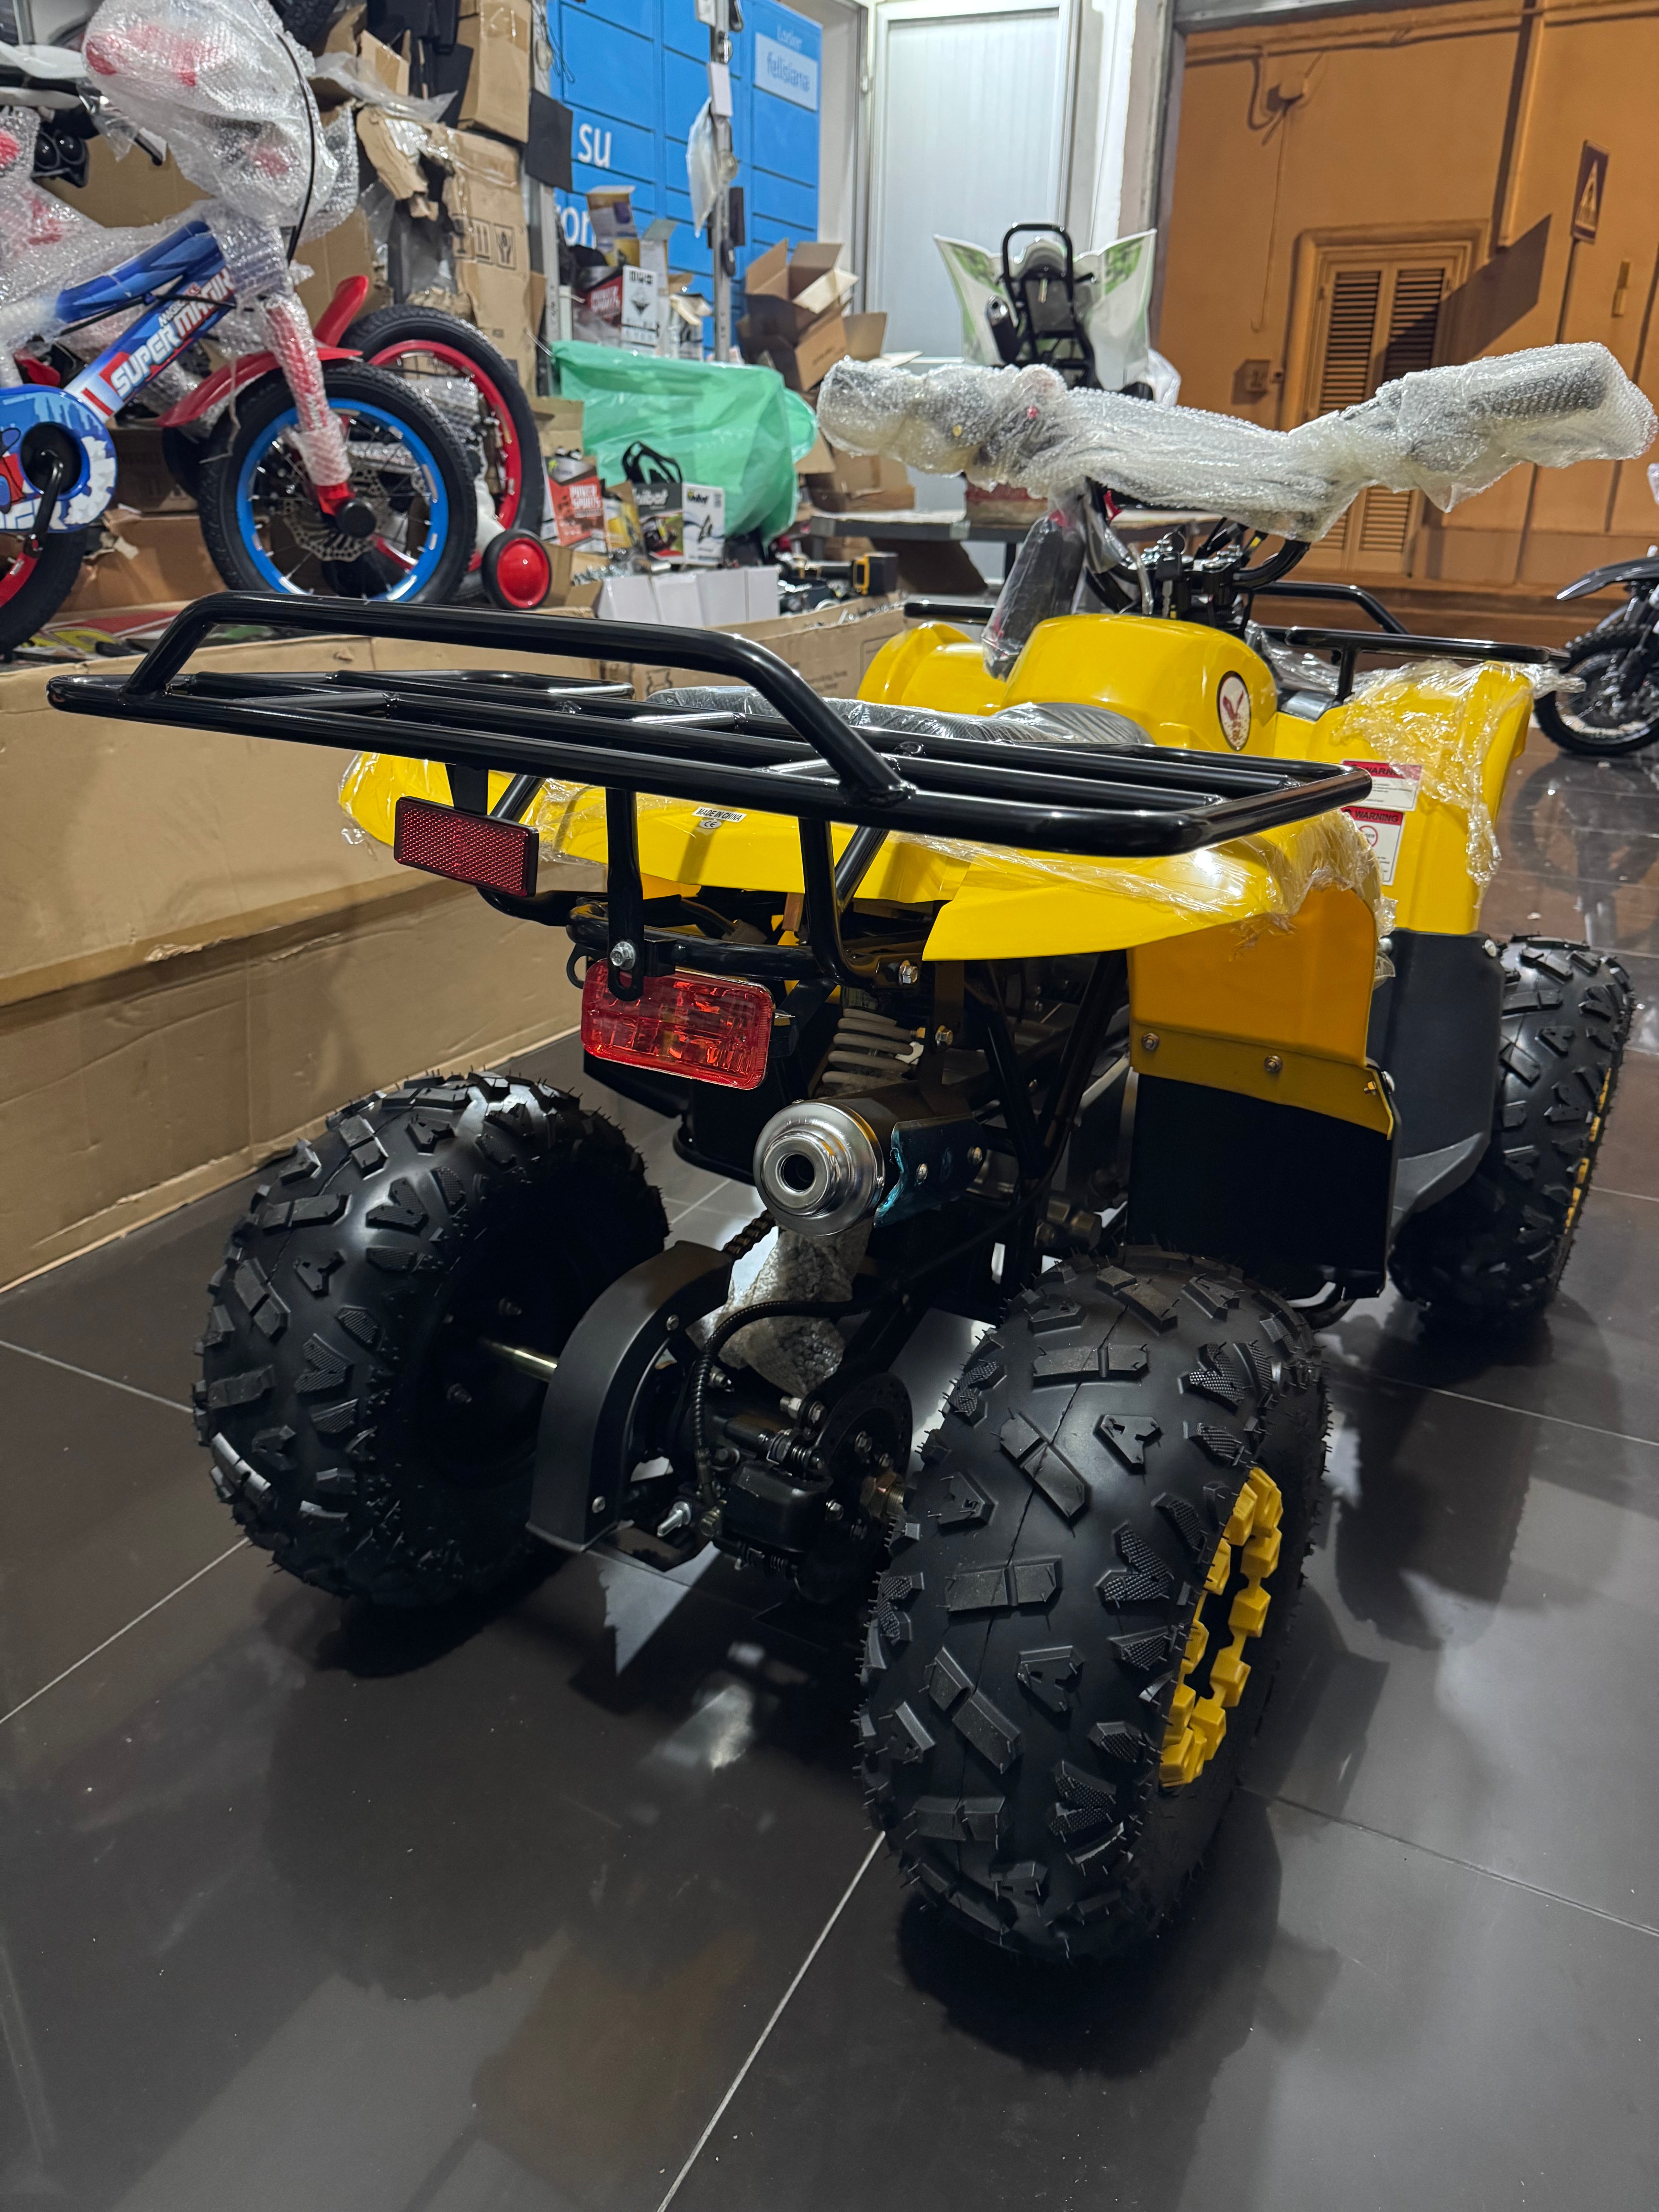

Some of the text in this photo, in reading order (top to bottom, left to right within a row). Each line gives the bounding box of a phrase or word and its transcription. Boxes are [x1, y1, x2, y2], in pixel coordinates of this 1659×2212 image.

[578, 123, 611, 168] su
[110, 324, 183, 398] SUPER
[697, 808, 716, 817] MADE
[722, 812, 742, 821] CHINA
[1355, 810, 1398, 823] WARNING
